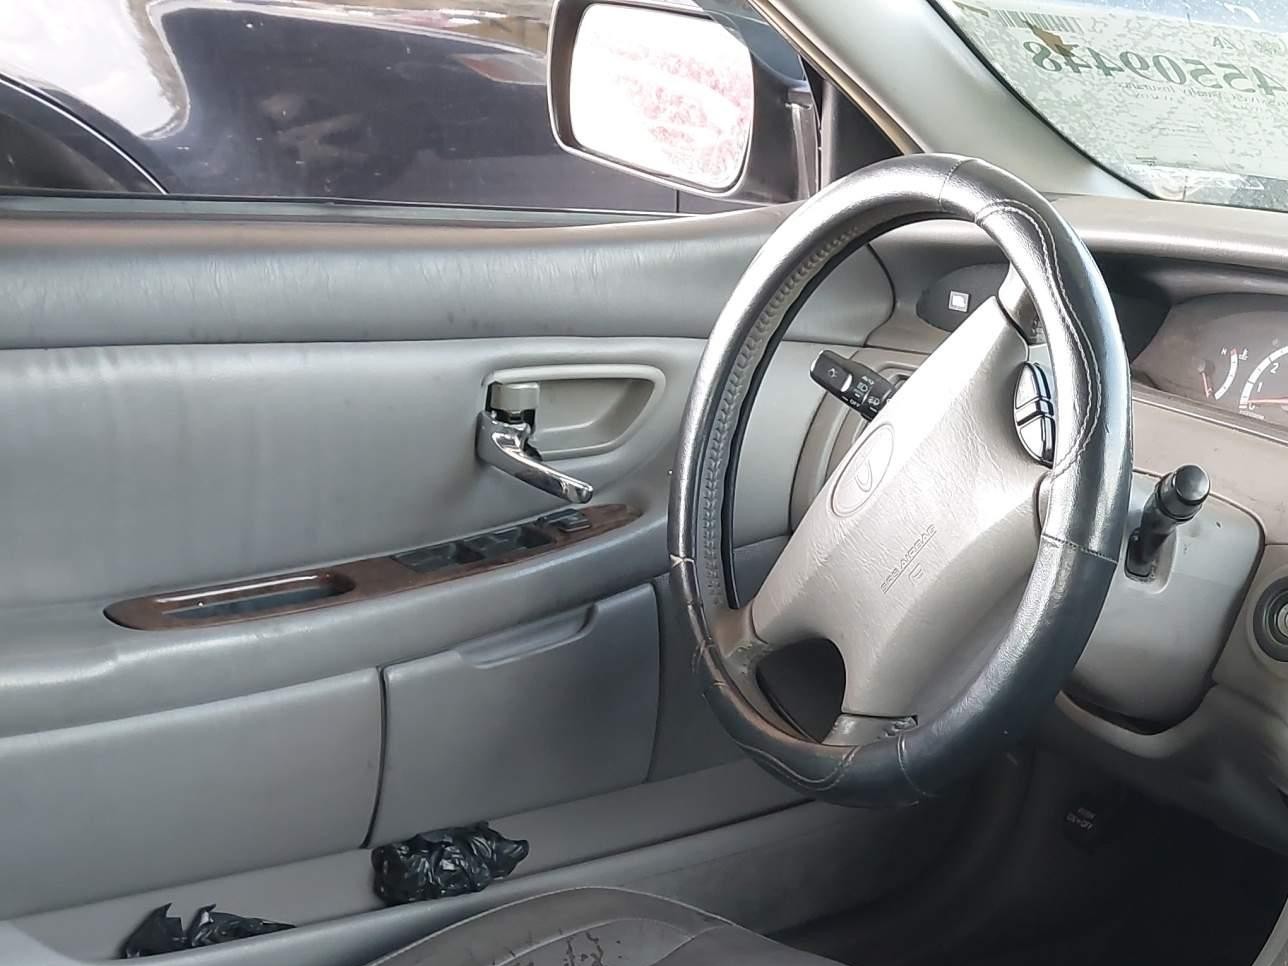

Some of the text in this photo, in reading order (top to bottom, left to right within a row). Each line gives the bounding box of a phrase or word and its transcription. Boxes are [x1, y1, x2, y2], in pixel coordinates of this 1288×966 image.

[1270, 362, 1279, 374] 2
[1256, 382, 1263, 392] 1
[900, 523, 937, 570] AIRBAG
